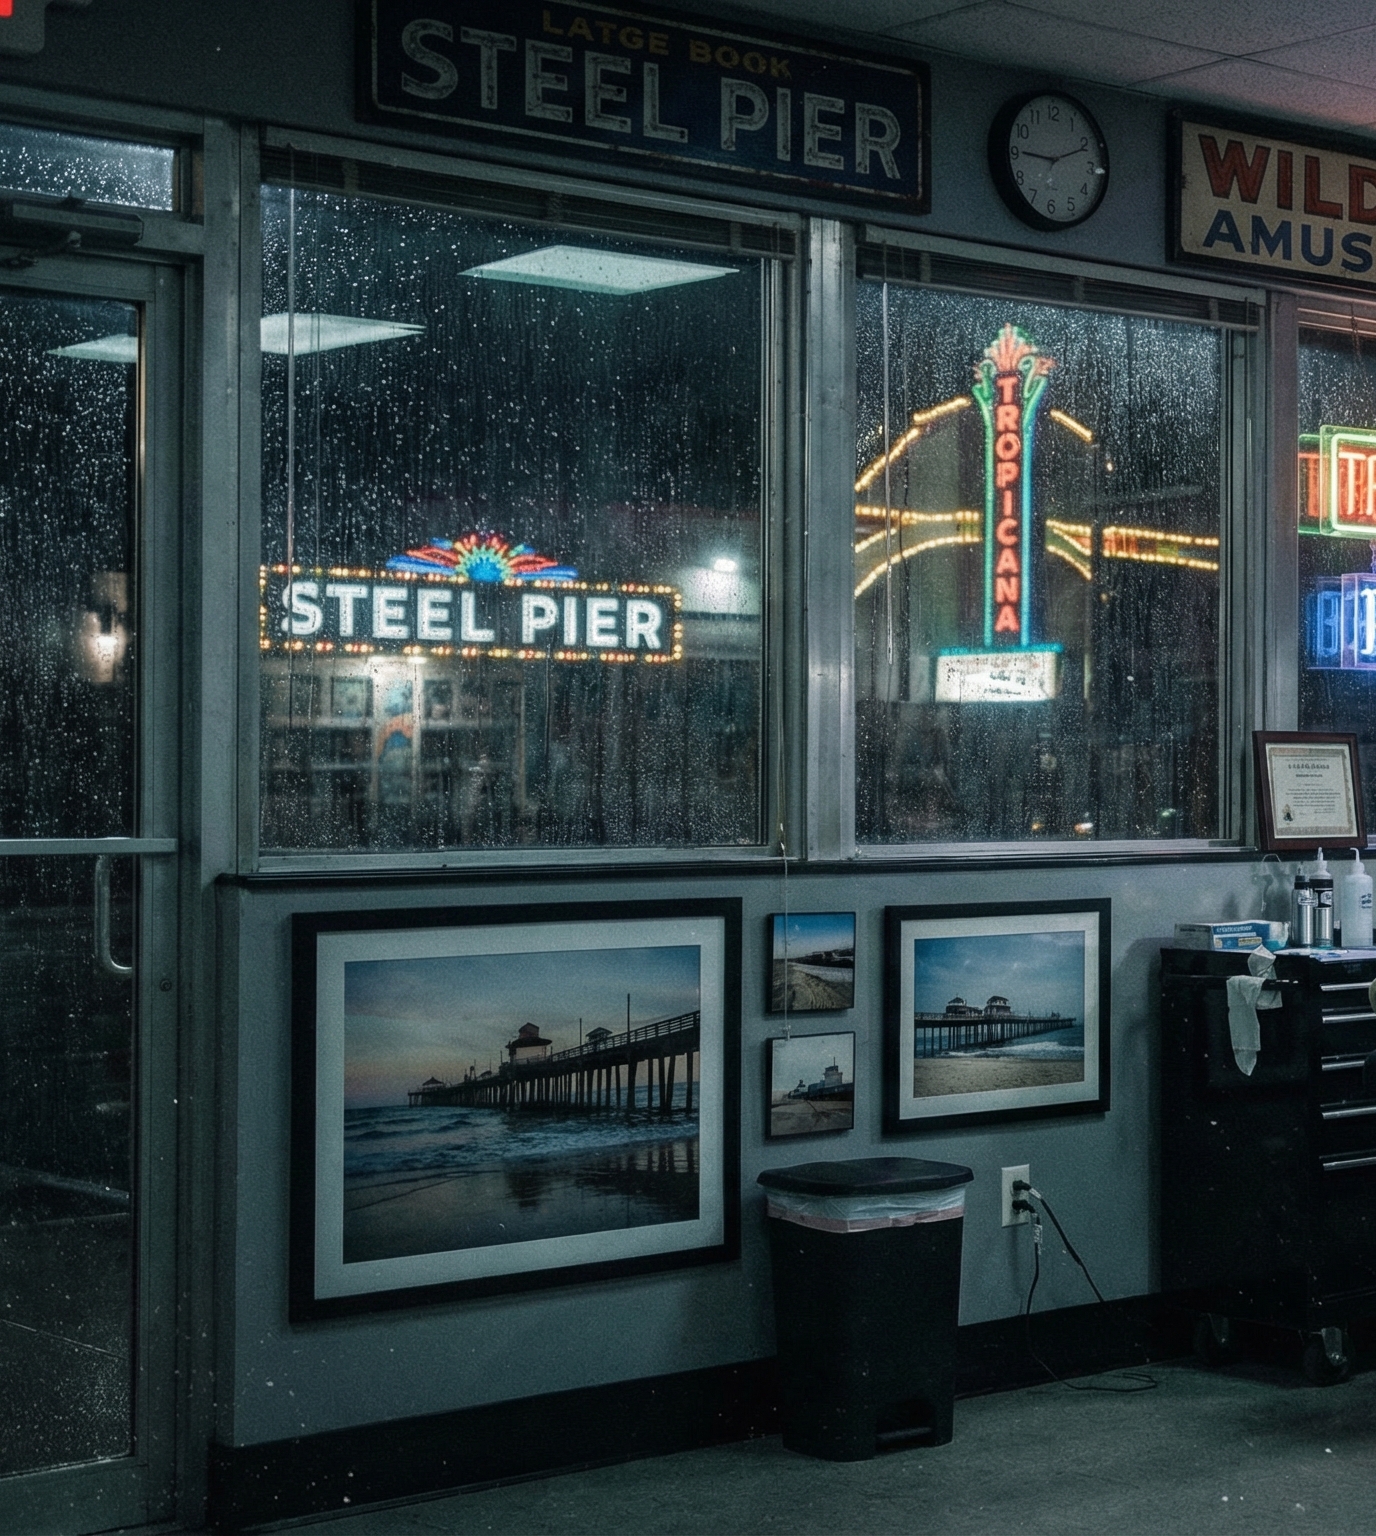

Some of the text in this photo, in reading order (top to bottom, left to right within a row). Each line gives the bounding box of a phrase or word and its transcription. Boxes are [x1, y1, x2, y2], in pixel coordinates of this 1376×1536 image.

[542, 9, 792, 79] LATGE BOOK
[401, 18, 902, 180] STEEL PIER
[1030, 108, 1041, 125] 11
[1048, 104, 1060, 122] 12
[1016, 122, 1029, 140] 10
[1079, 136, 1088, 152] 2
[1010, 145, 1019, 160] 9
[1016, 170, 1025, 186] 8
[1029, 188, 1038, 204] 7
[1080, 182, 1088, 196] 4
[1047, 199, 1056, 215] 6
[1067, 196, 1076, 212] 5
[995, 375, 1022, 632] TROPICANA
[281, 581, 662, 650] STEEL PIER
